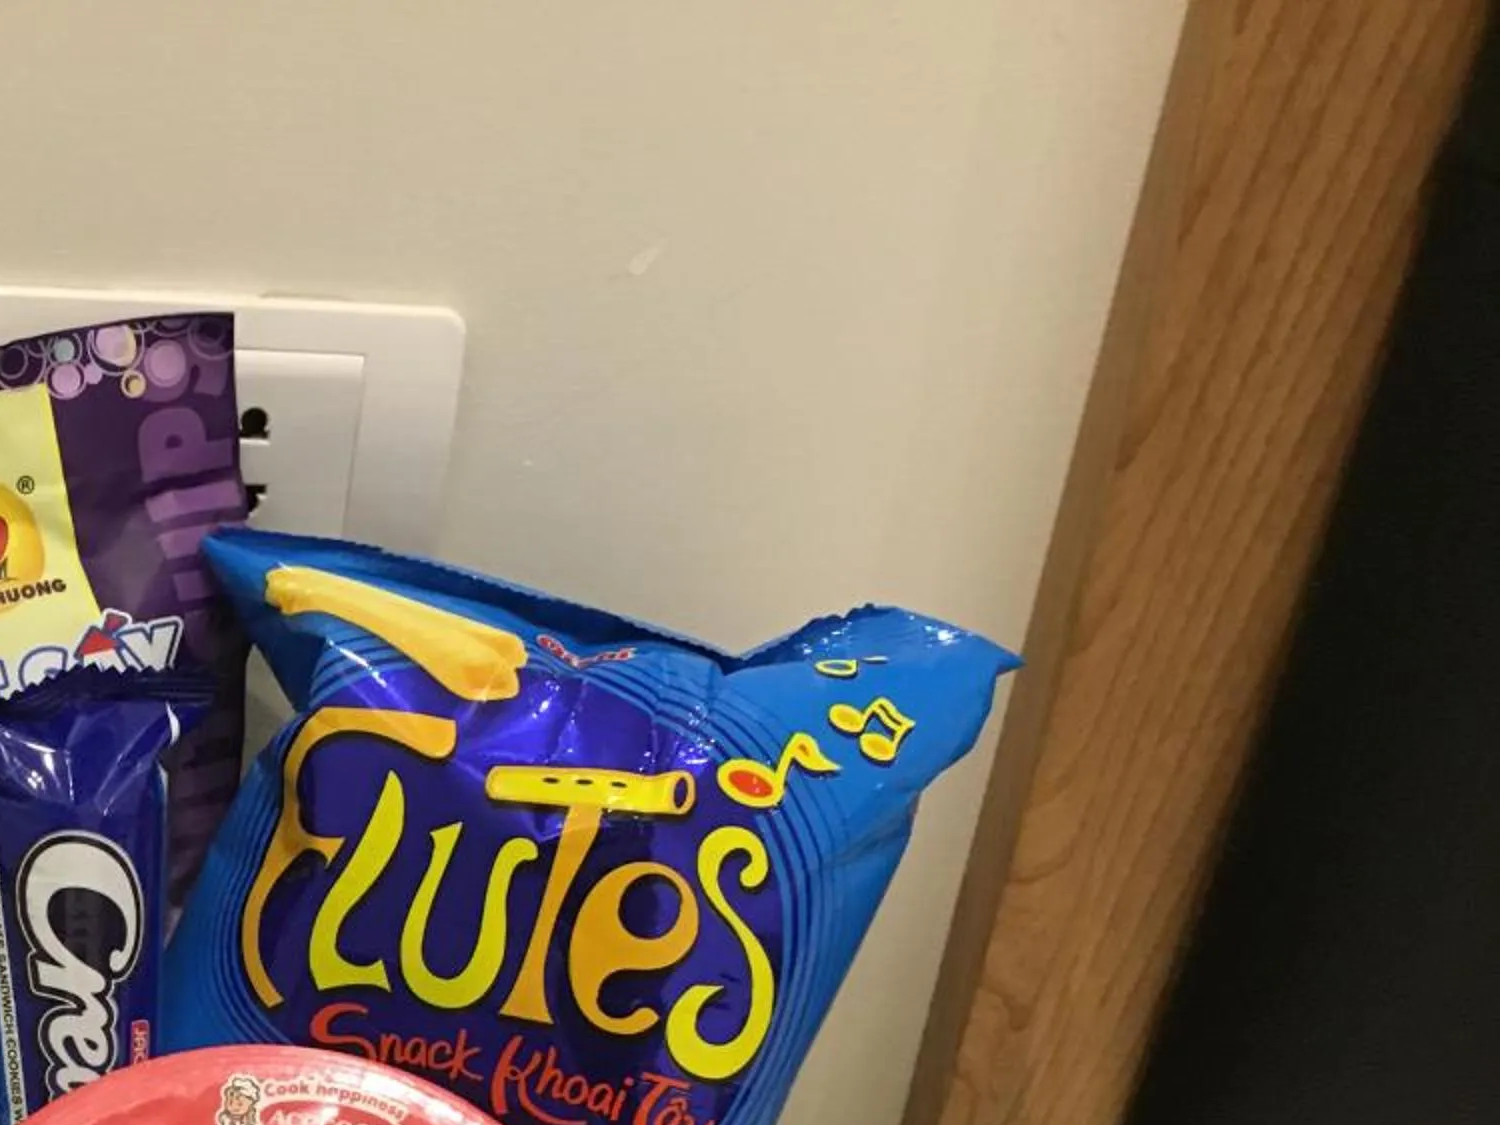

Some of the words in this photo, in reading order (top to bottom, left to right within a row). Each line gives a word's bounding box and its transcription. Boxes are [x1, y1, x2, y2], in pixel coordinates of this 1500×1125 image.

[18, 831, 143, 1100] Cre
[5, 1037, 23, 1105] COOKIES
[309, 1002, 483, 1082] Snack
[263, 1080, 310, 1099] Cook
